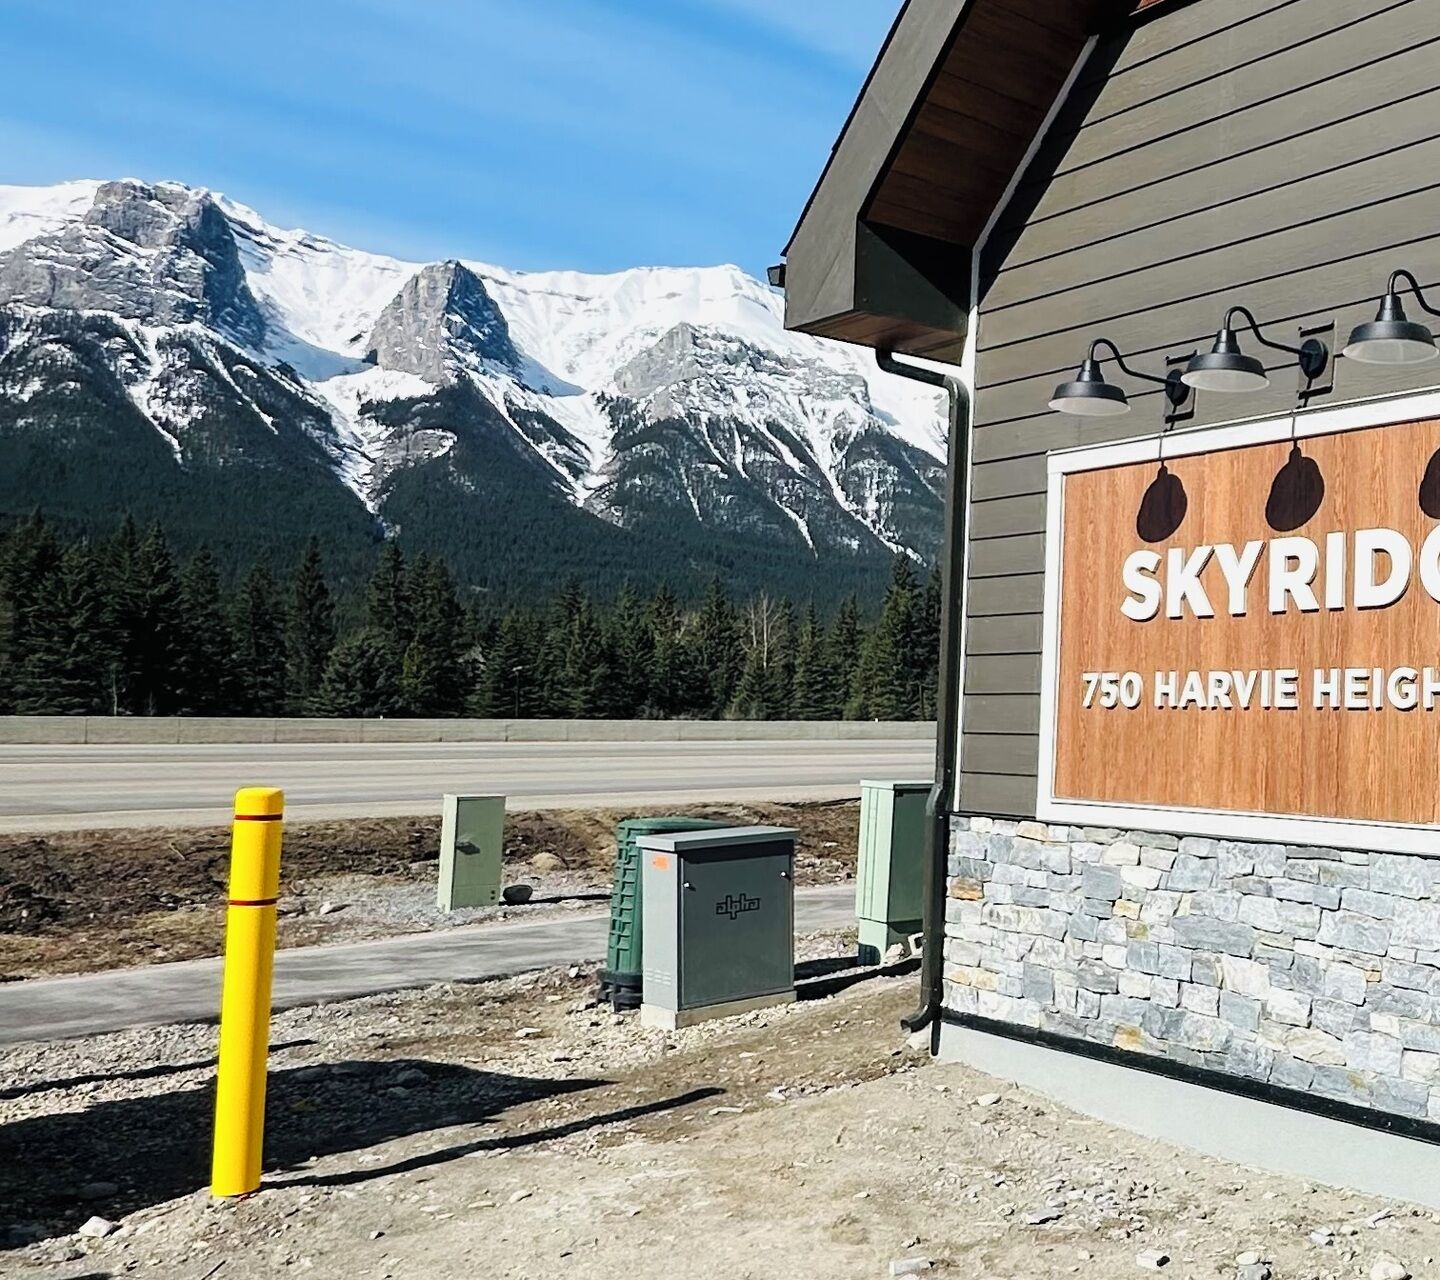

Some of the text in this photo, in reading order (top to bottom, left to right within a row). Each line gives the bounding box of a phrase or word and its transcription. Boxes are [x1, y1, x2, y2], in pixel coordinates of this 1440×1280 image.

[1082, 670, 1144, 710] 750
[1153, 667, 1299, 711] HARVIE
[715, 893, 761, 921] alpha
